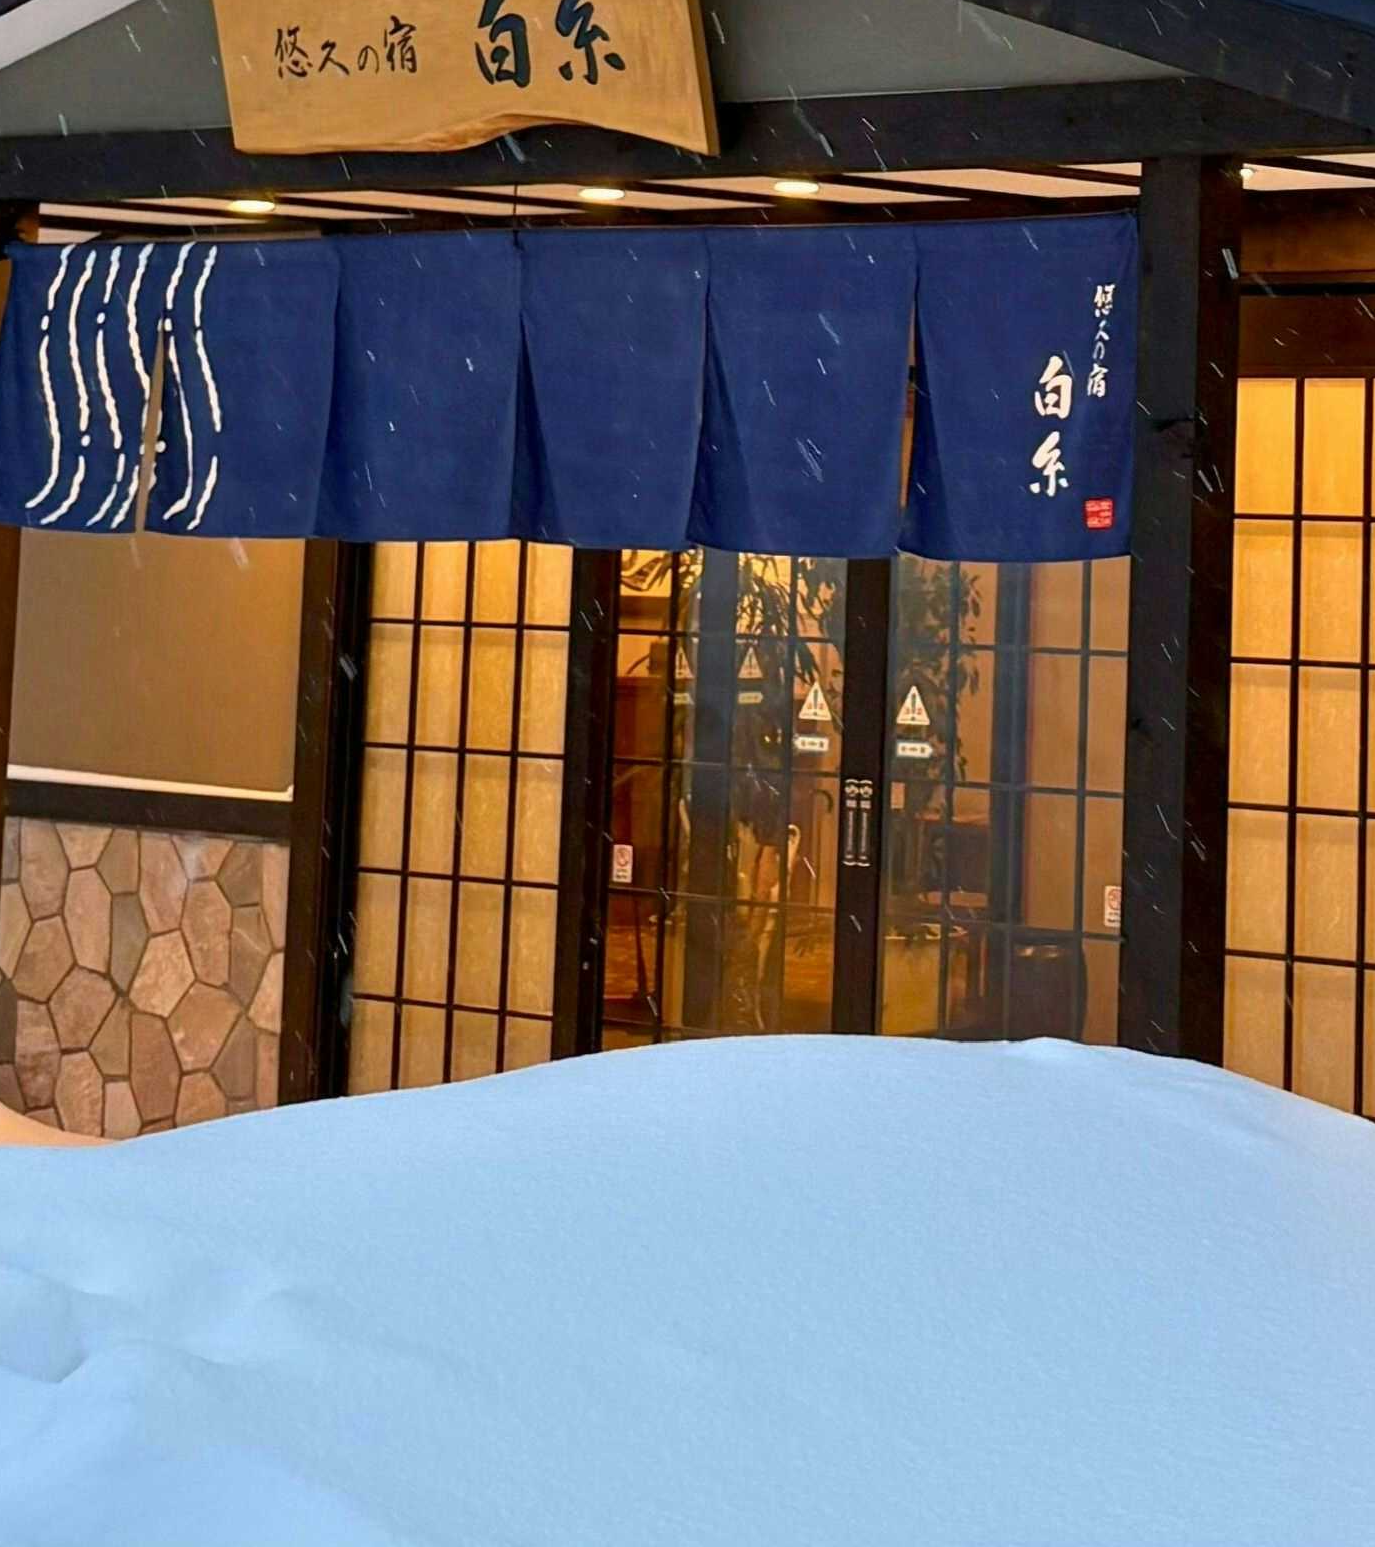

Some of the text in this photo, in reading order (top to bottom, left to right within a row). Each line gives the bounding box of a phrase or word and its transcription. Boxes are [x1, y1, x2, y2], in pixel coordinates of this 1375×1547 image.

[273, 15, 418, 80] 悠久の宿
[1086, 283, 1116, 398] 悠久の宿
[1029, 355, 1074, 497] 白糸
